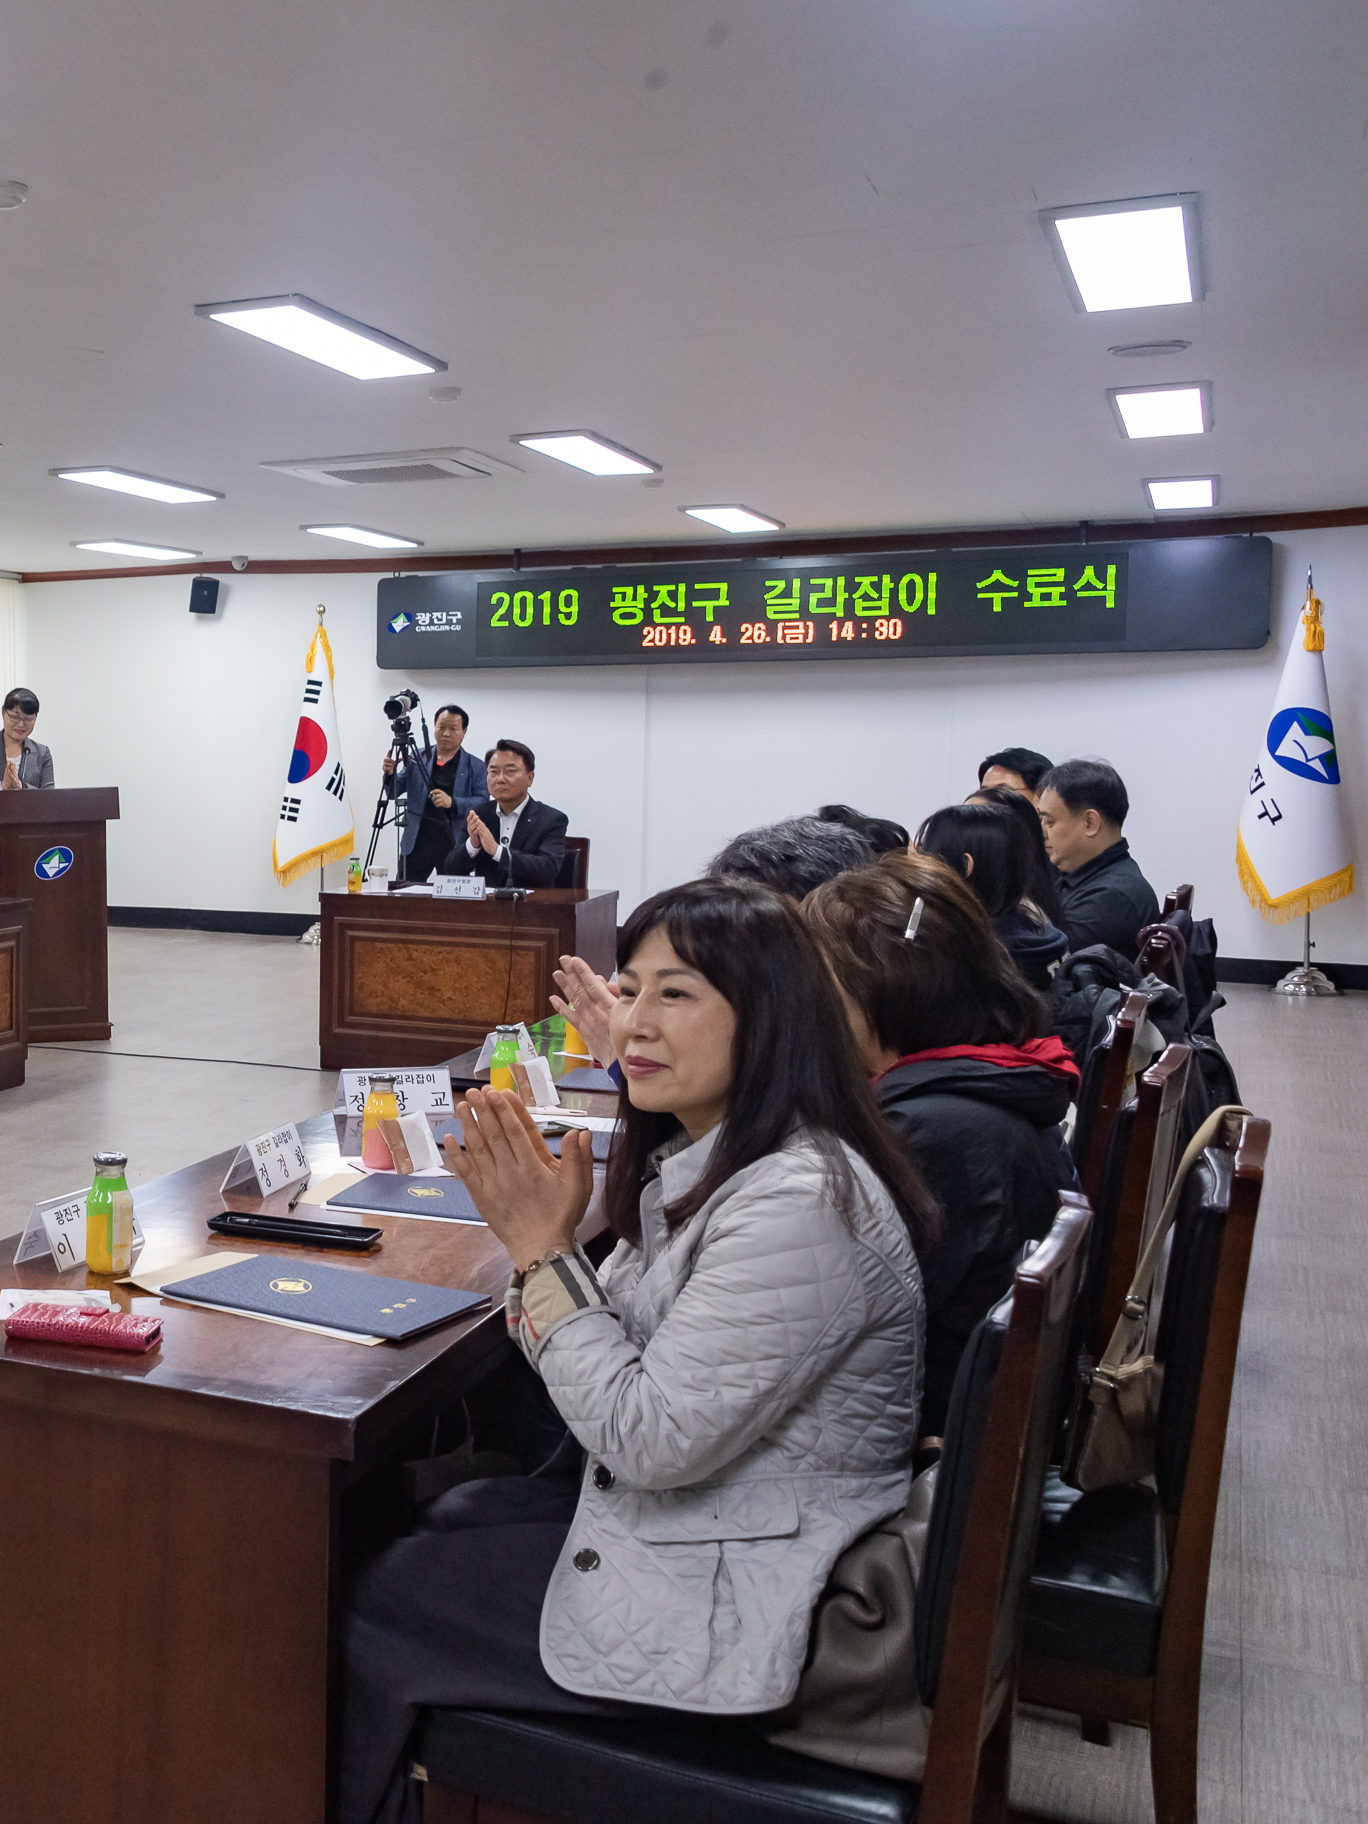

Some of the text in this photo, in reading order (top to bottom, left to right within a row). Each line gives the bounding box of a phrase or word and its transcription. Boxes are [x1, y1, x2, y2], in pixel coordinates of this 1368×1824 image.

[490, 564, 1117, 628] 2019 광진구 길라잡이 수료식
[415, 611, 463, 626] 광진구
[415, 624, 462, 632] GWANGJIN-GU
[642, 625, 696, 646] 2019.
[708, 625, 727, 644] 4.
[1249, 763, 1283, 826] 진구
[430, 1092, 450, 1107] 교
[255, 1129, 294, 1156] 광진구 길라잡이
[258, 1162, 272, 1188] 정
[277, 1154, 290, 1178] 경
[54, 1204, 81, 1226] 광진구
[57, 1233, 76, 1262] 이
